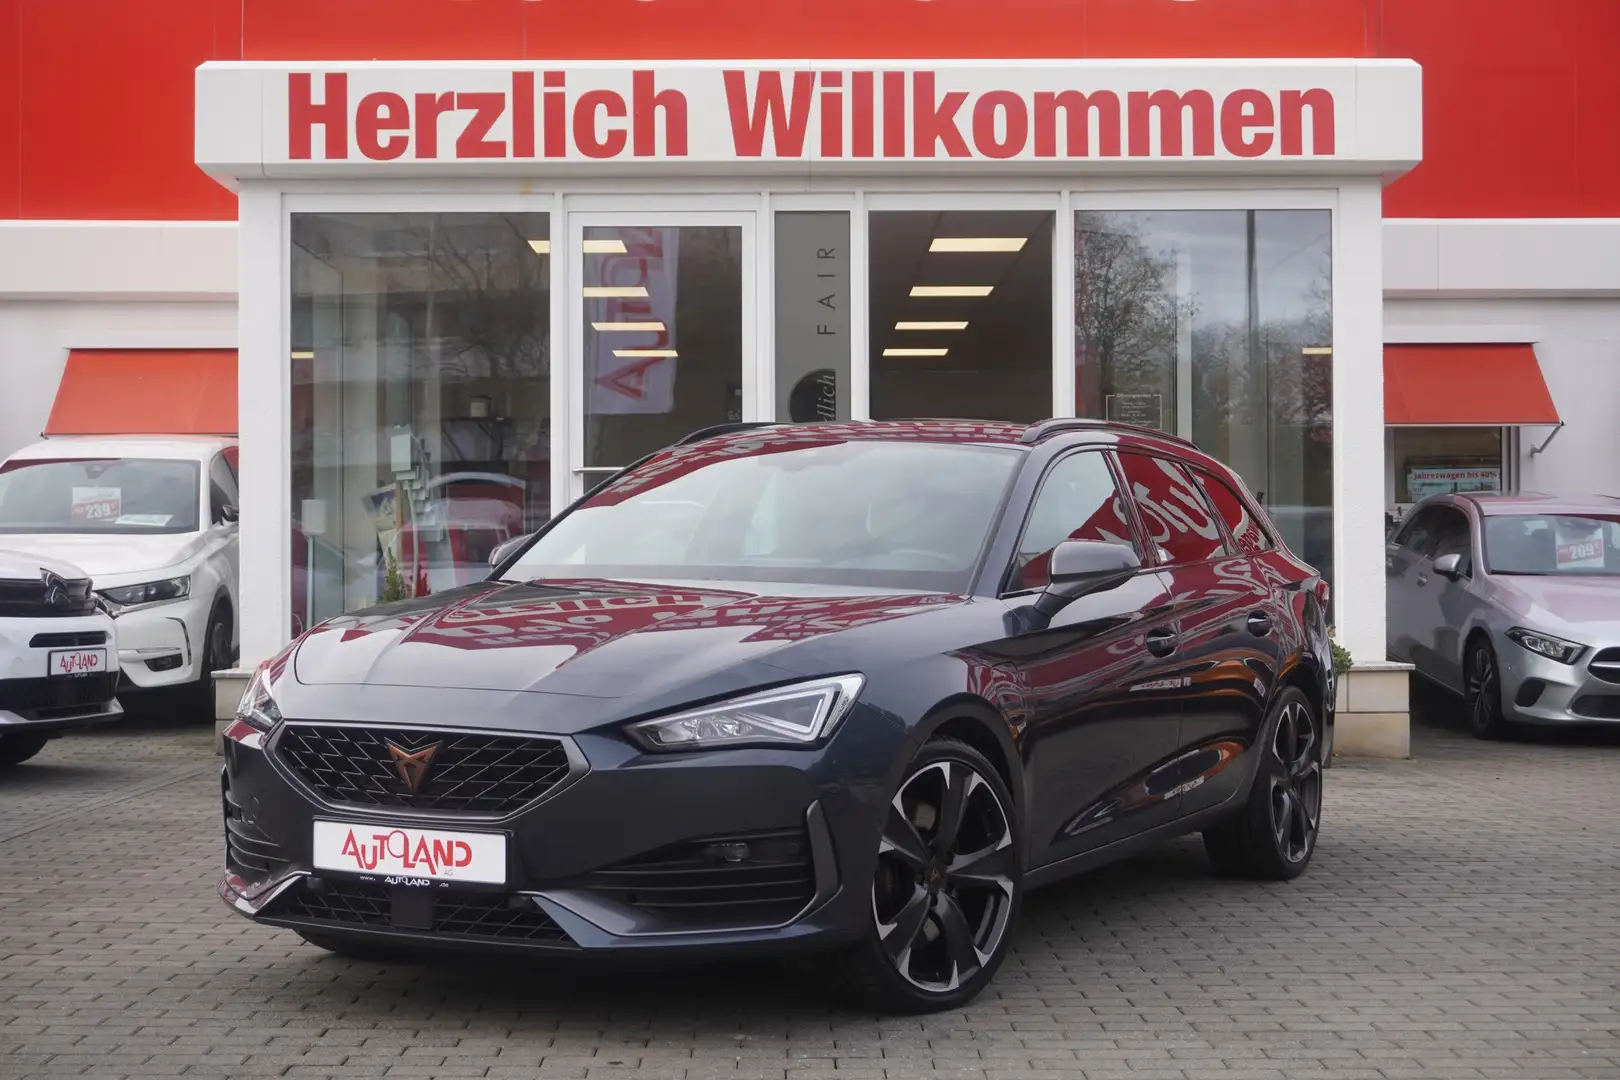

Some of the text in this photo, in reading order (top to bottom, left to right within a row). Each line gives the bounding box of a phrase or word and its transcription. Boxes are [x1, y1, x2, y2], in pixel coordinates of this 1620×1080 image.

[288, 70, 1335, 162] Herzlich Willkommen
[817, 248, 836, 335] FAIR
[816, 373, 836, 421] dlich
[60, 652, 98, 673] AUTOLAND
[342, 828, 473, 875] AUTOLAND
[384, 875, 430, 887] AUTOLAND
